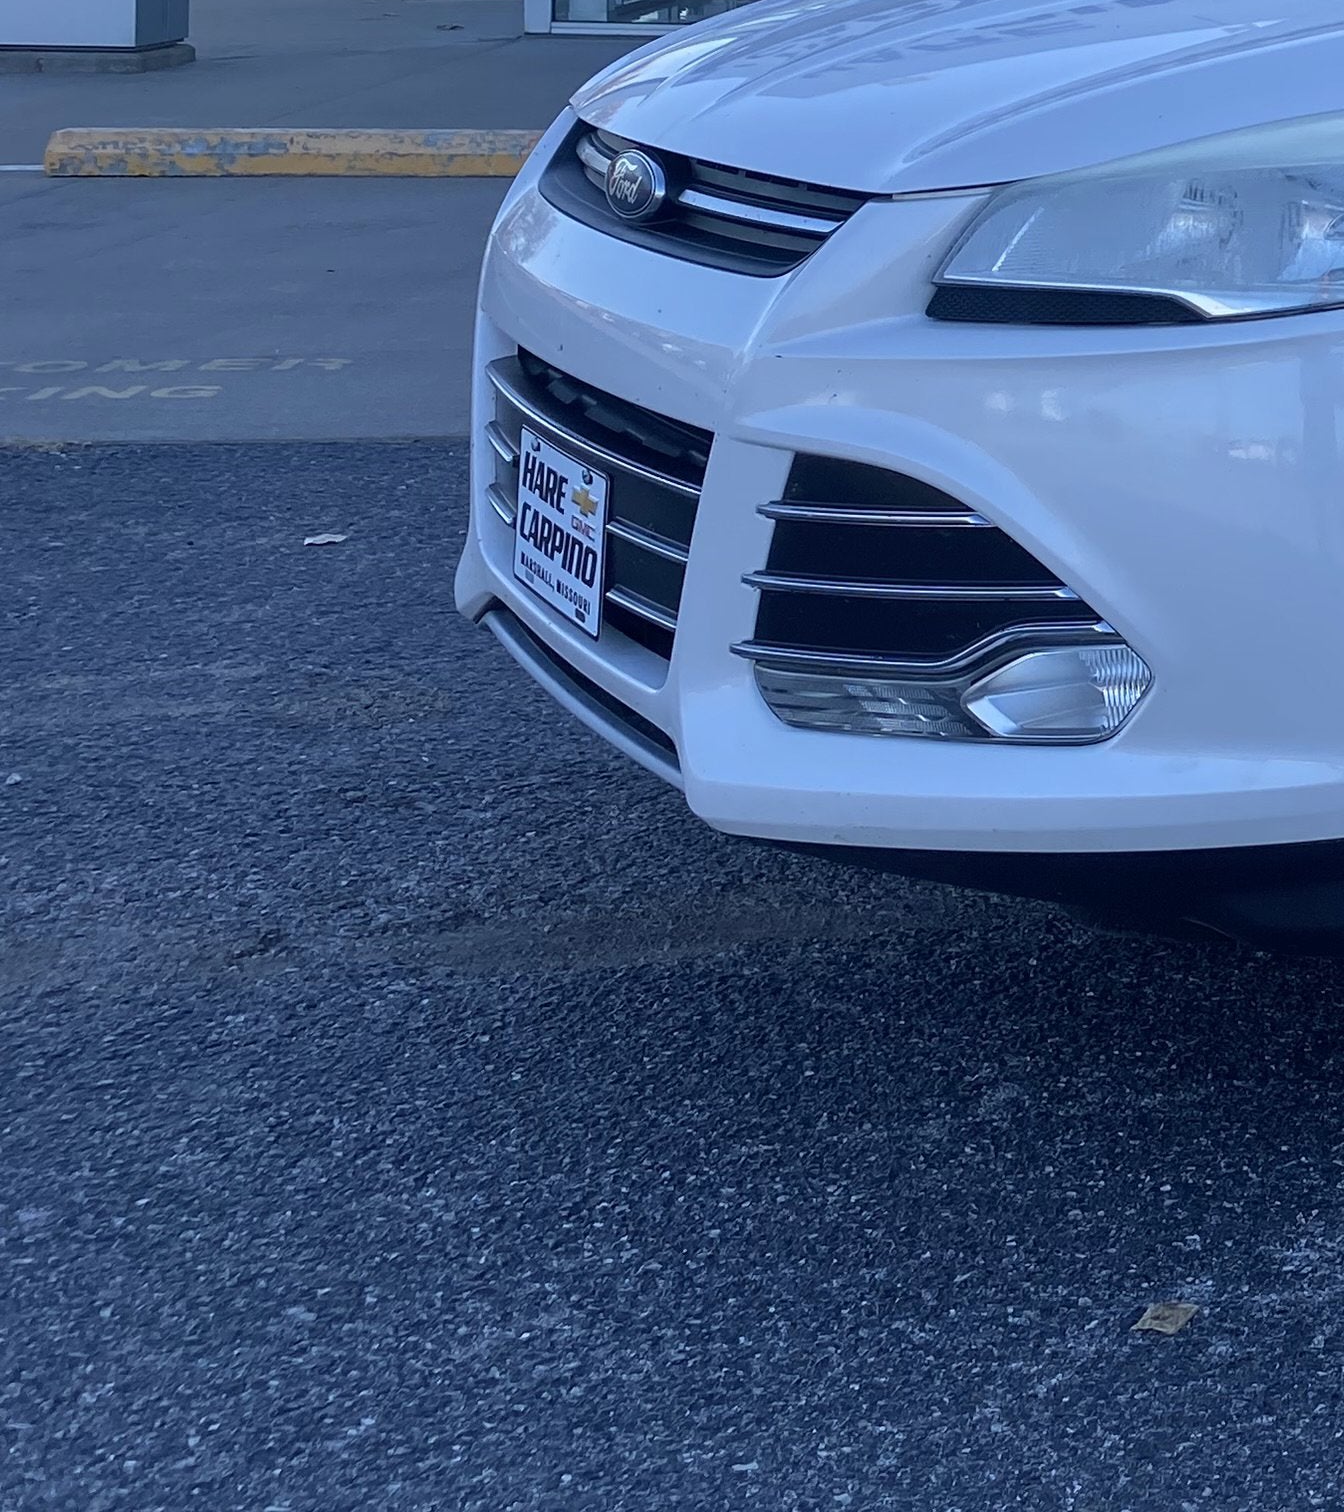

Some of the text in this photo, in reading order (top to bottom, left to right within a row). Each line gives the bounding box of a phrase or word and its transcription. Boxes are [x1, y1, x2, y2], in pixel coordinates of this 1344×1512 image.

[609, 157, 643, 205] Ford
[521, 451, 568, 515] HARE
[519, 501, 598, 589] CARPINO
[556, 579, 591, 616] MISSOURI
